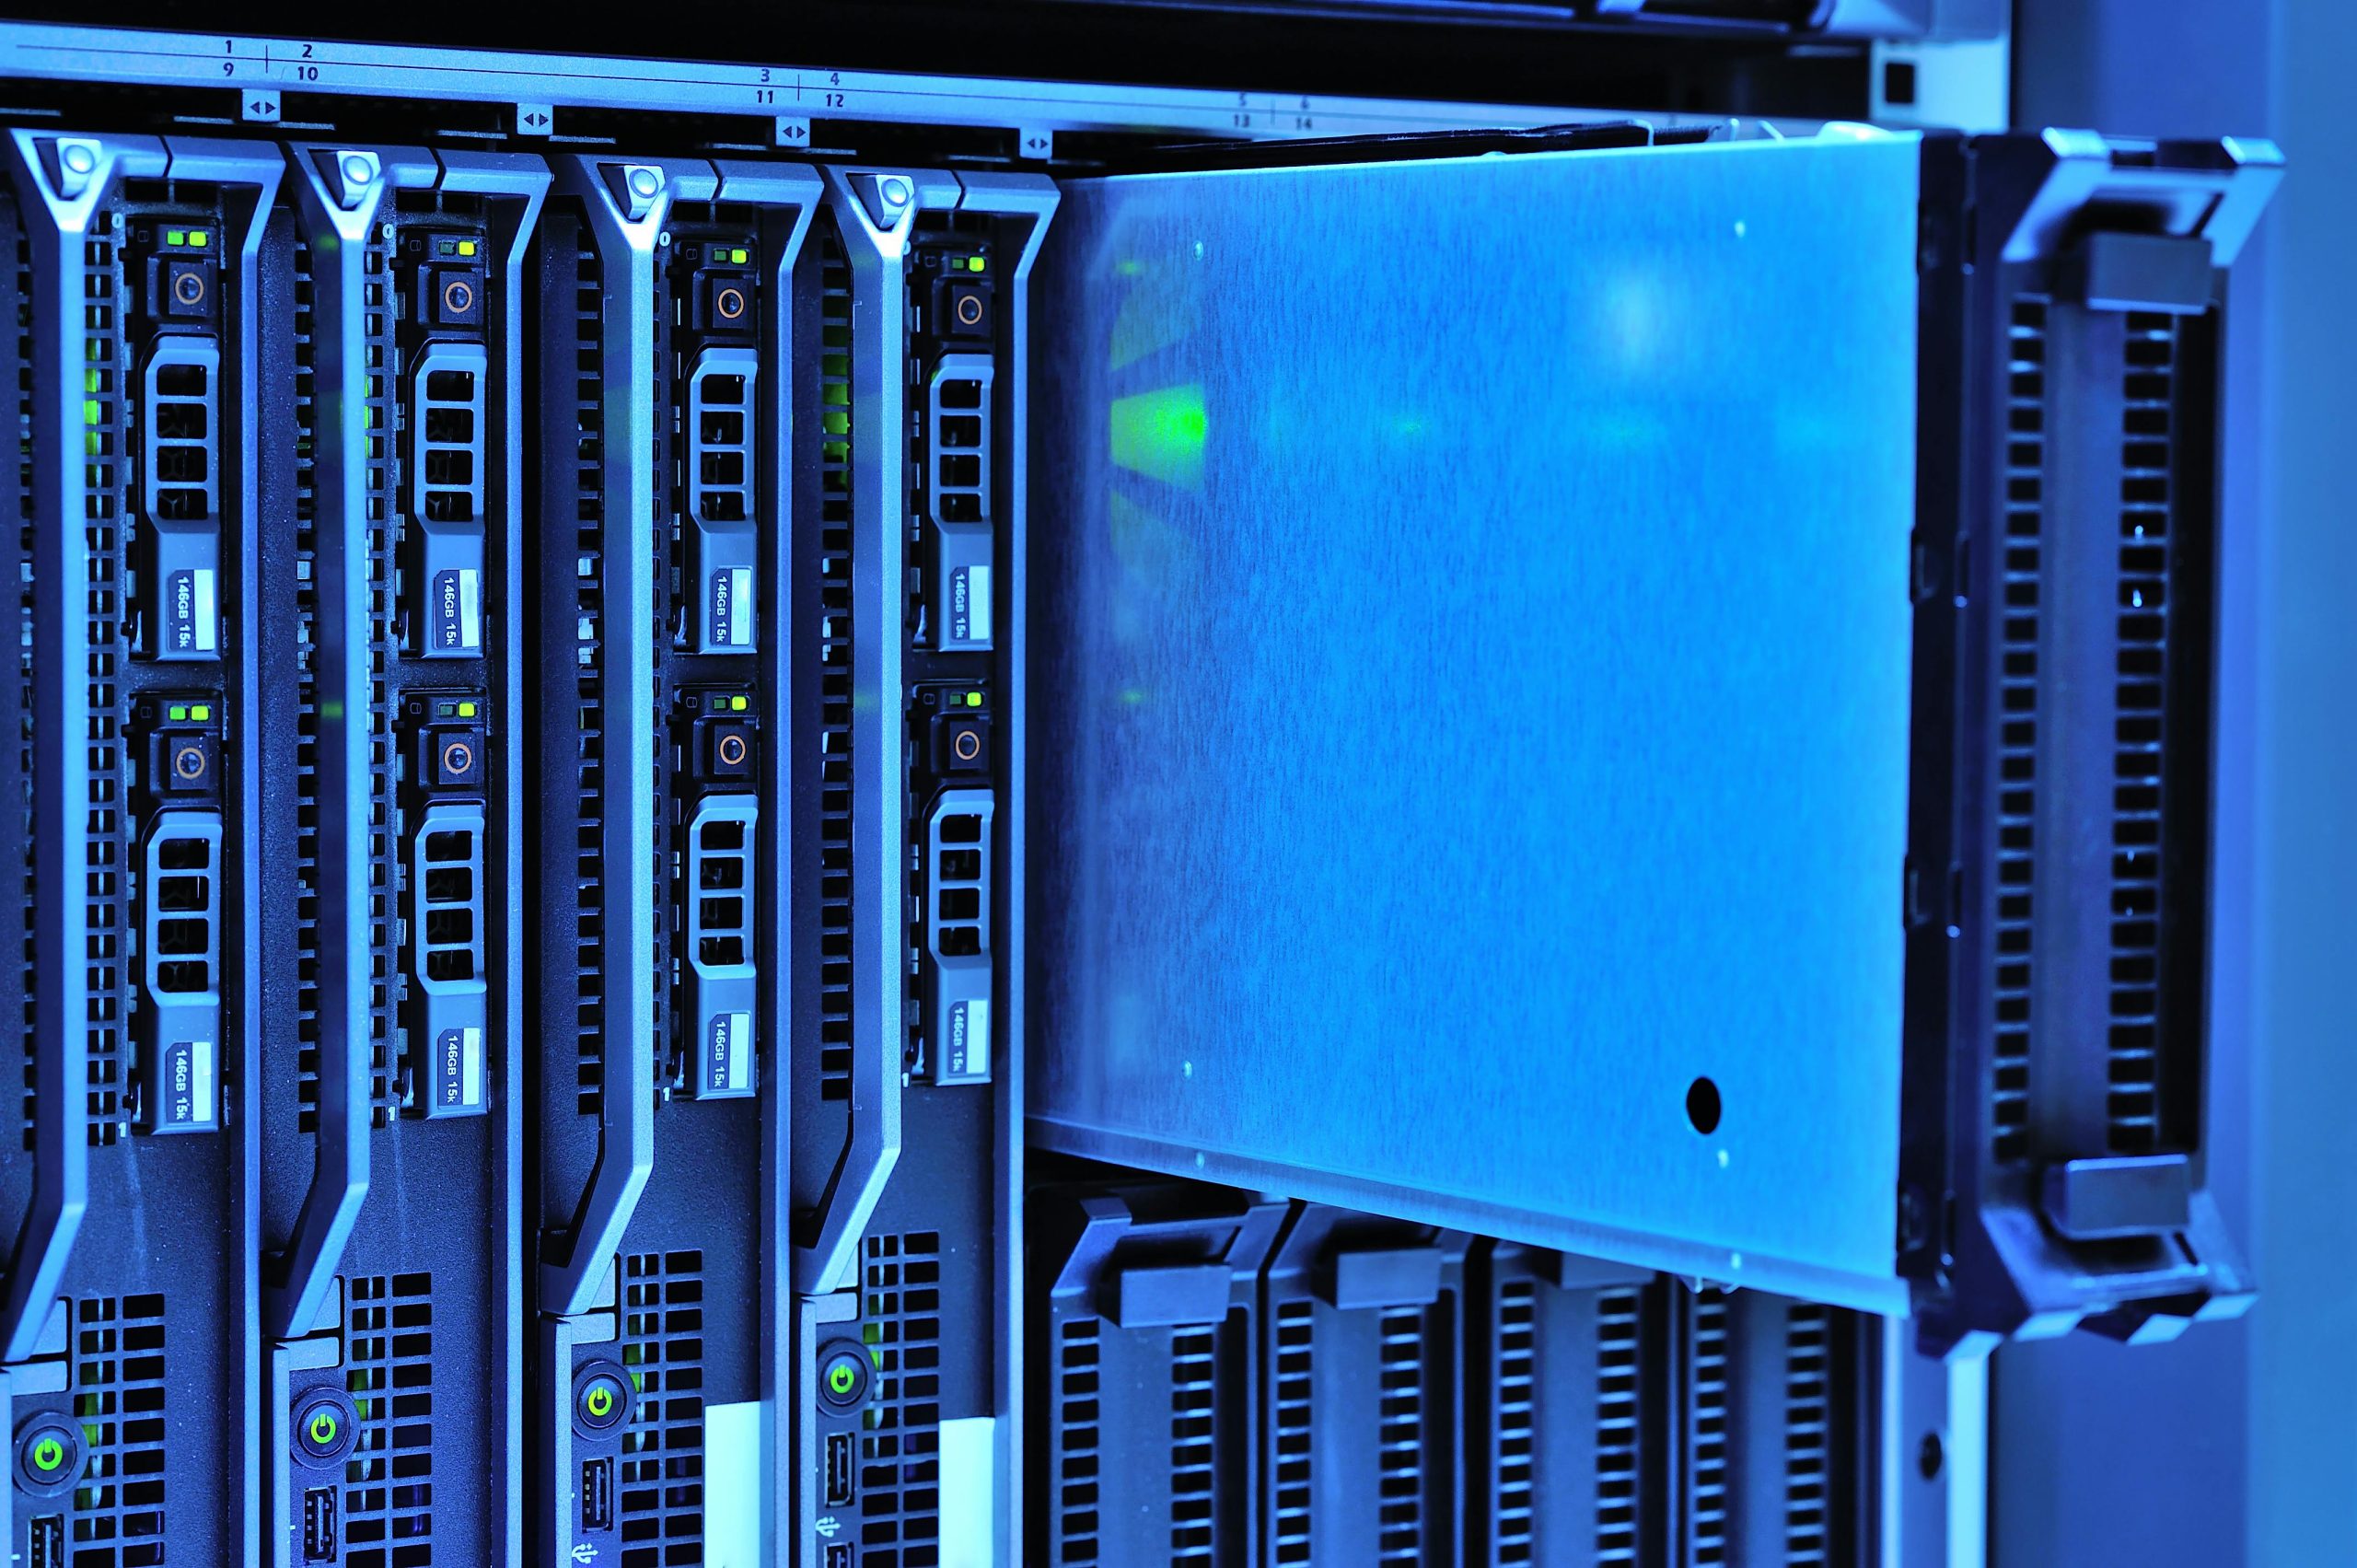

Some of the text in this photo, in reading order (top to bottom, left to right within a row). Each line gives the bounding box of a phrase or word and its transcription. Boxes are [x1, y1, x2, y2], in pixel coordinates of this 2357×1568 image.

[225, 40, 232, 53] 1
[302, 44, 313, 58] 2
[223, 62, 234, 77] 9
[297, 65, 319, 81] 10
[761, 68, 771, 83] 3
[830, 72, 840, 86] 4
[757, 89, 774, 104] 11
[826, 93, 844, 108] 12
[1233, 113, 1250, 127] 13
[1295, 117, 1313, 131] 14
[955, 572, 966, 613] 146GB
[178, 576, 191, 648] 146GB 15k
[444, 576, 457, 646] 146GB 15k
[715, 575, 727, 643] 146GB 15k
[953, 1006, 964, 1047] 146GB
[714, 1020, 726, 1088] 146GB 15k
[447, 1035, 459, 1104] 146GB 15k
[175, 1049, 188, 1121] 146GB 15k
[662, 1086, 671, 1102] 1
[388, 1106, 396, 1121] 1
[118, 1121, 127, 1138] 1
